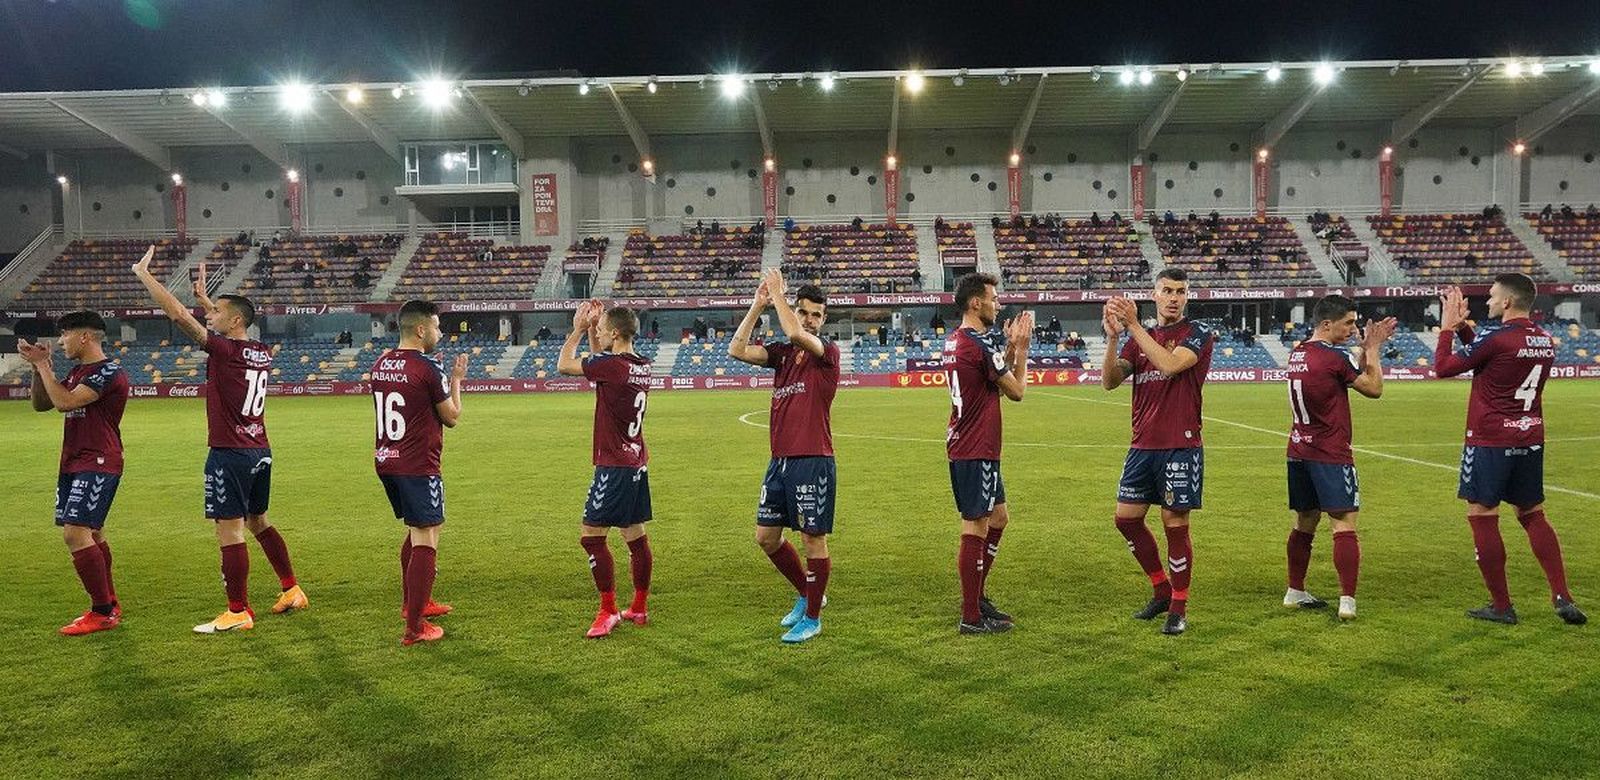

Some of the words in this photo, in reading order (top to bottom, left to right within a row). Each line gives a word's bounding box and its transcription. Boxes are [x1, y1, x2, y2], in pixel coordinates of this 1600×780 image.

[867, 295, 890, 305] Diario
[898, 295, 941, 304] Pontevedra
[1209, 290, 1233, 299] Diario
[1241, 289, 1284, 299] Pontevedra
[241, 369, 269, 417] 18
[1514, 364, 1543, 412] 4
[1550, 366, 1575, 378] BYB
[374, 391, 407, 441] 16
[628, 391, 647, 438] 3
